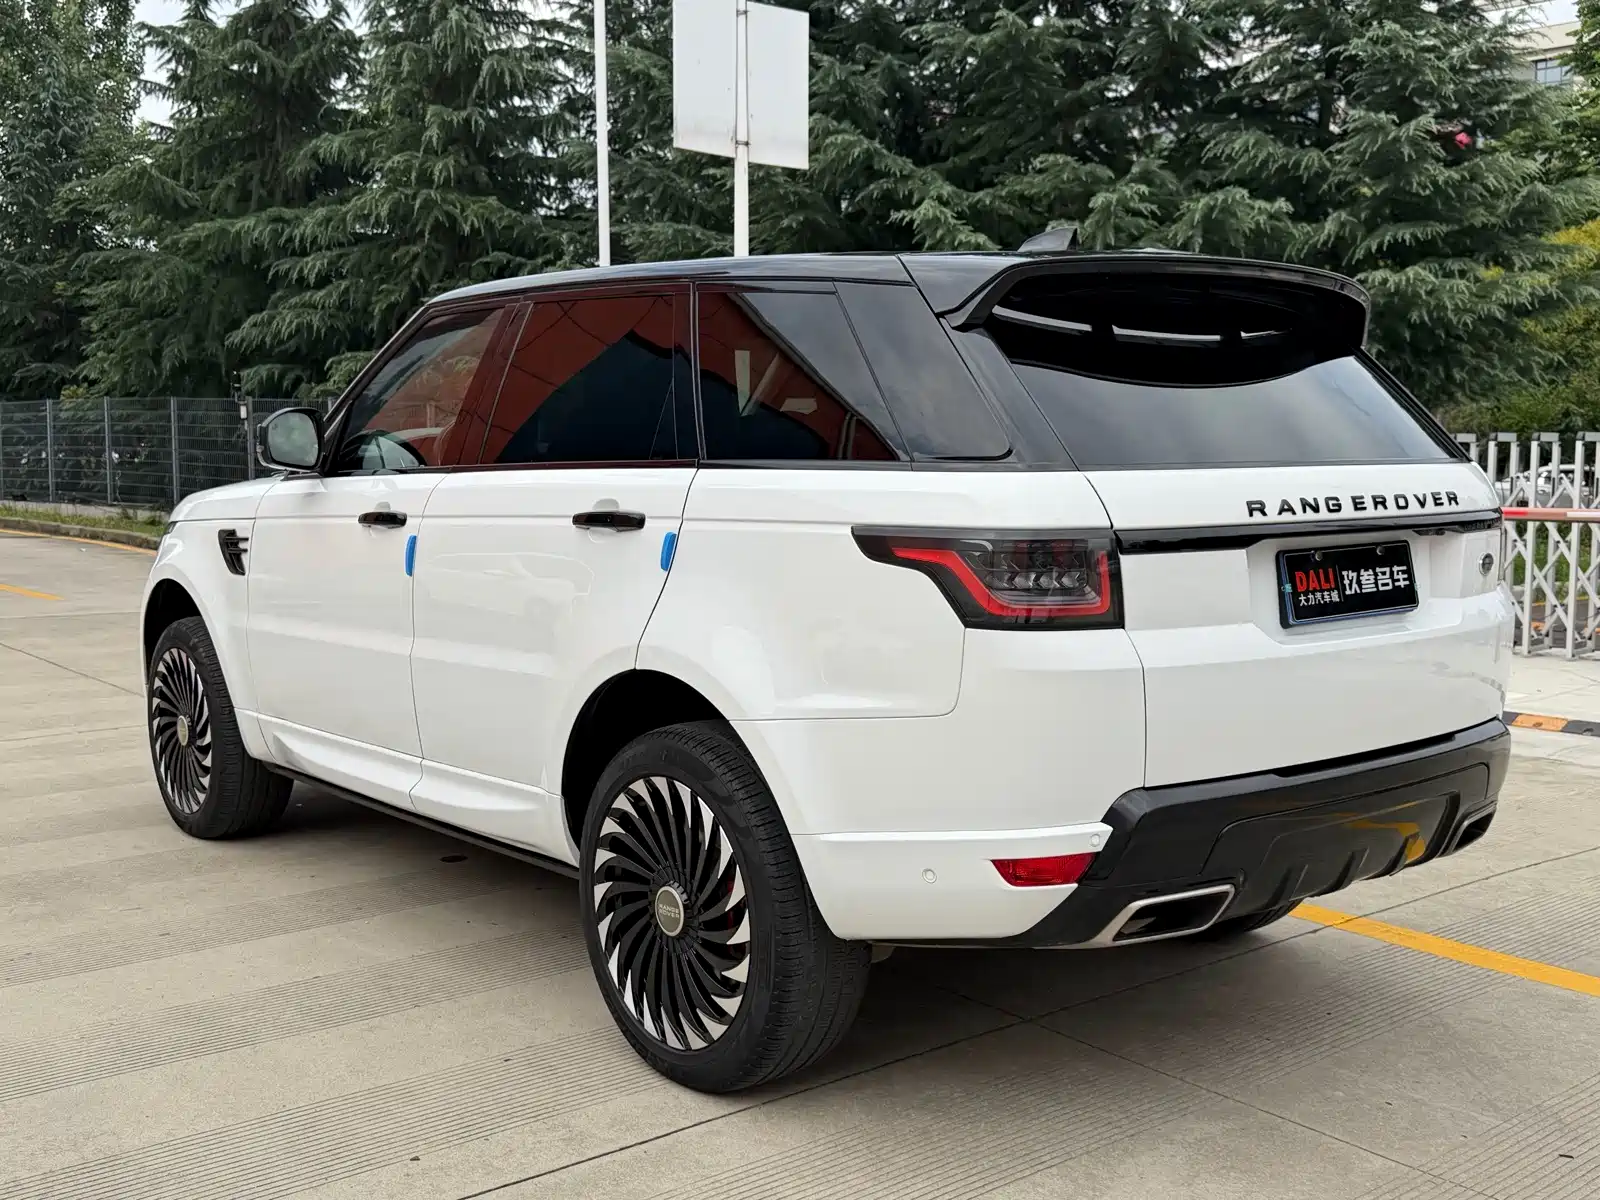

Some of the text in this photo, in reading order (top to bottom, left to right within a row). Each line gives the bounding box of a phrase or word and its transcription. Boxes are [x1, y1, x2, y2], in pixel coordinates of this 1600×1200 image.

[1295, 567, 1336, 592] DALI
[1341, 565, 1410, 595] 玖叁名车
[1298, 589, 1340, 607] 大力汽车城
